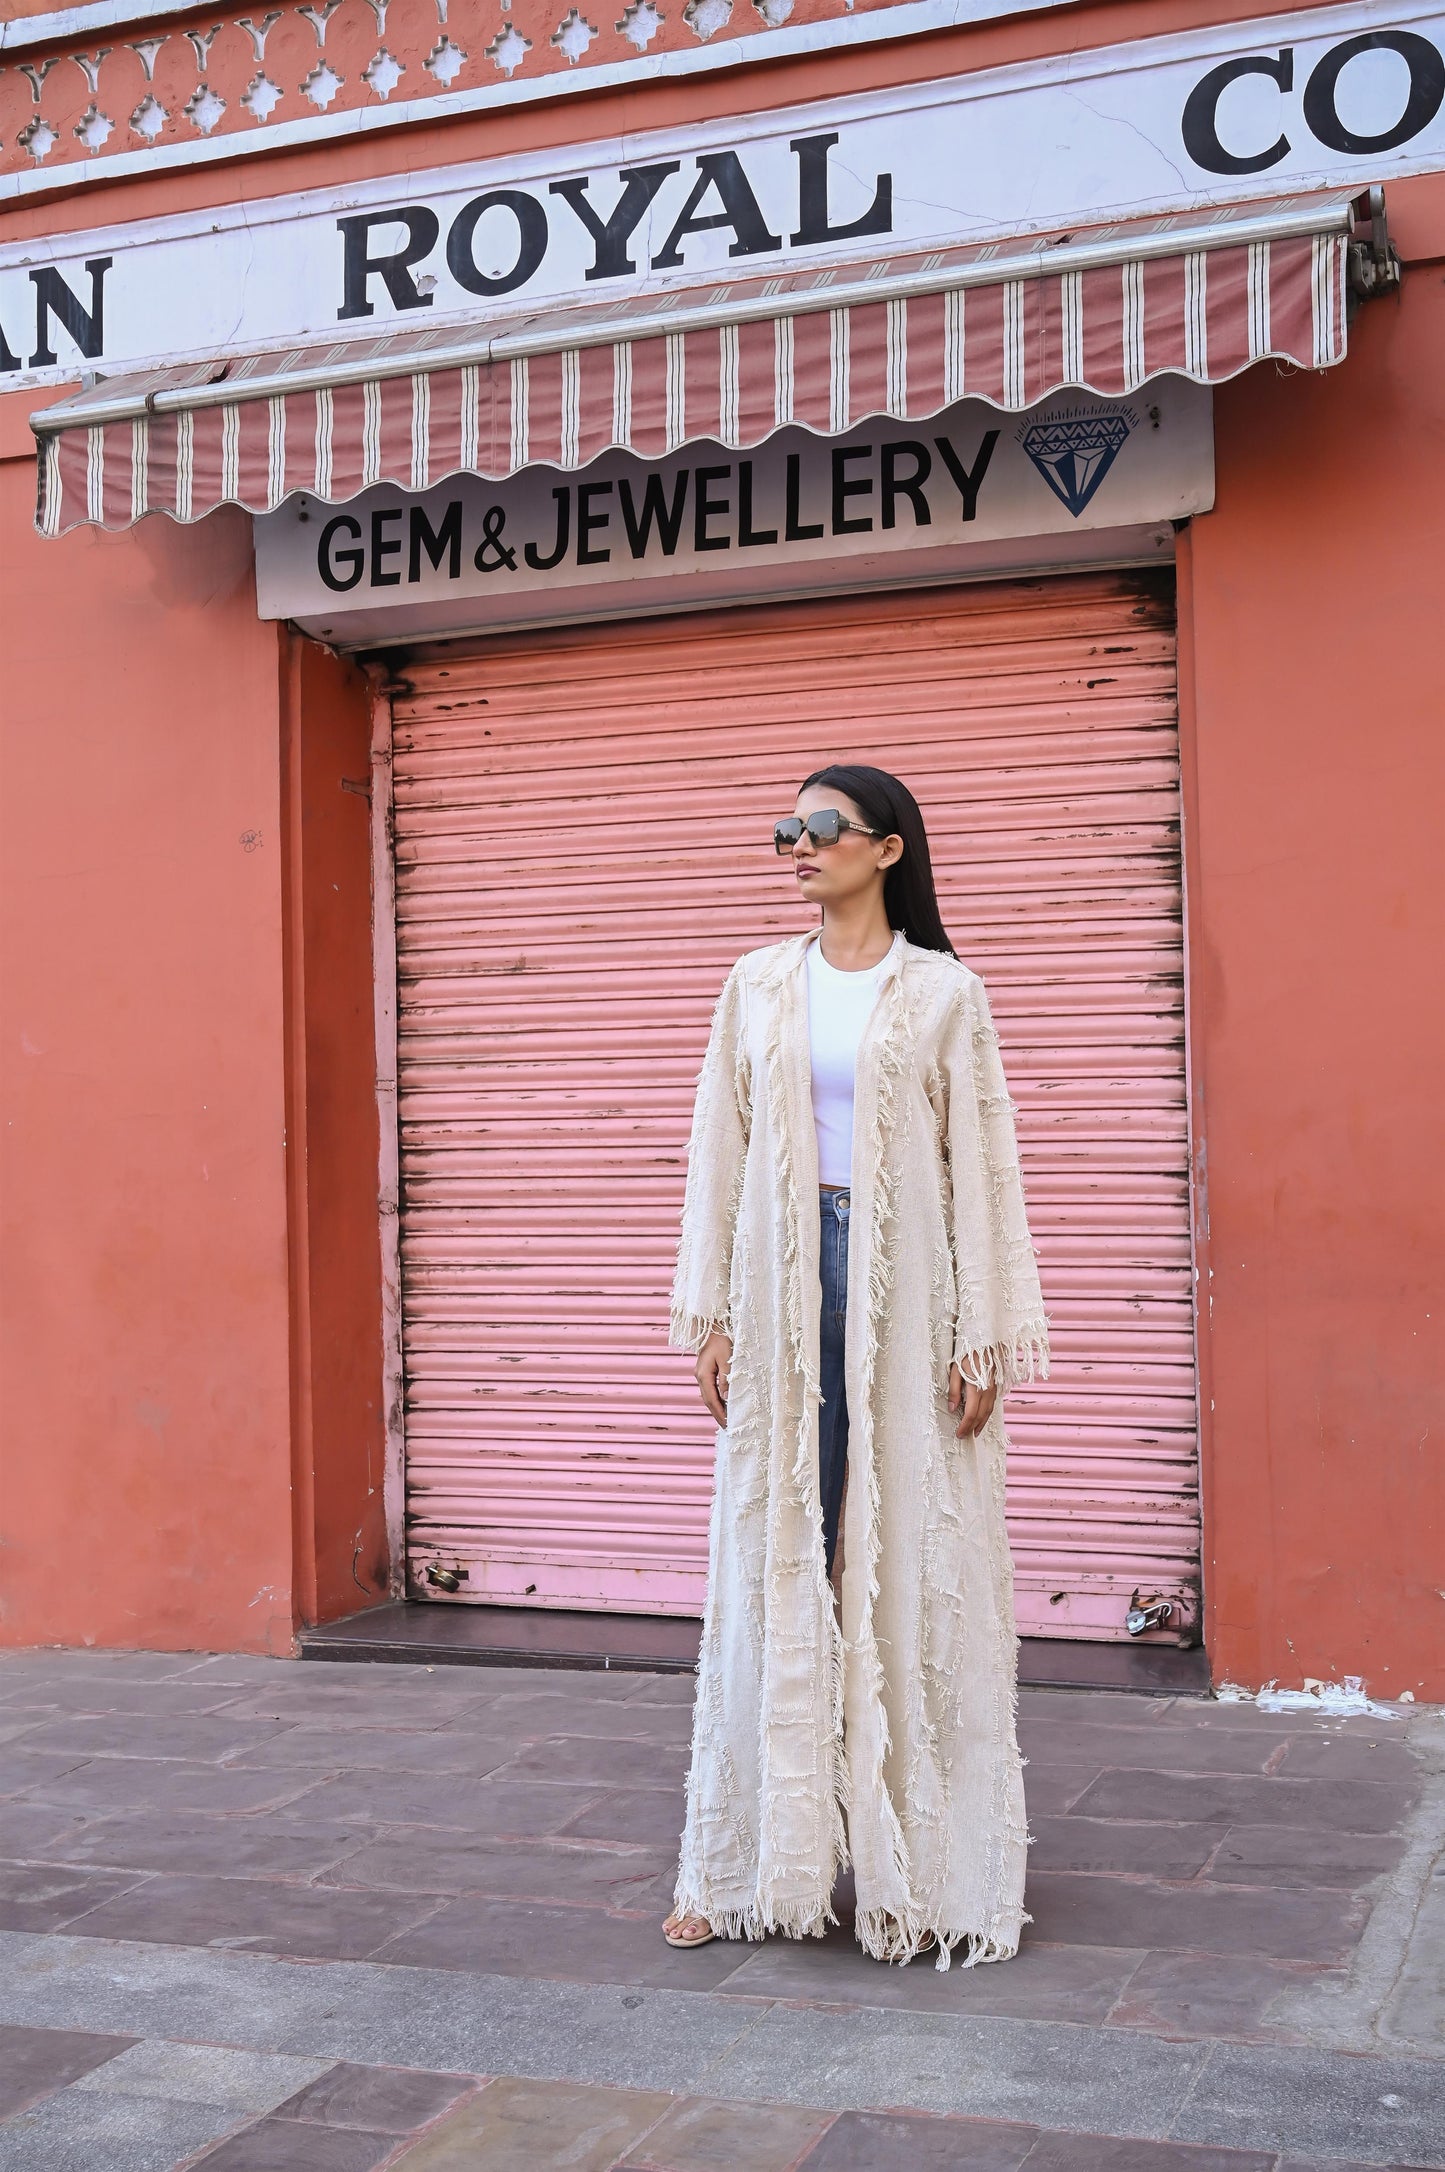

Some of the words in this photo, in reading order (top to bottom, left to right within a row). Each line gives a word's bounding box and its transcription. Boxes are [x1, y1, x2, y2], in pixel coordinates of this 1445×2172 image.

[0, 256, 113, 373] N
[336, 132, 893, 321] ROYAL
[1181, 29, 1445, 176] CO
